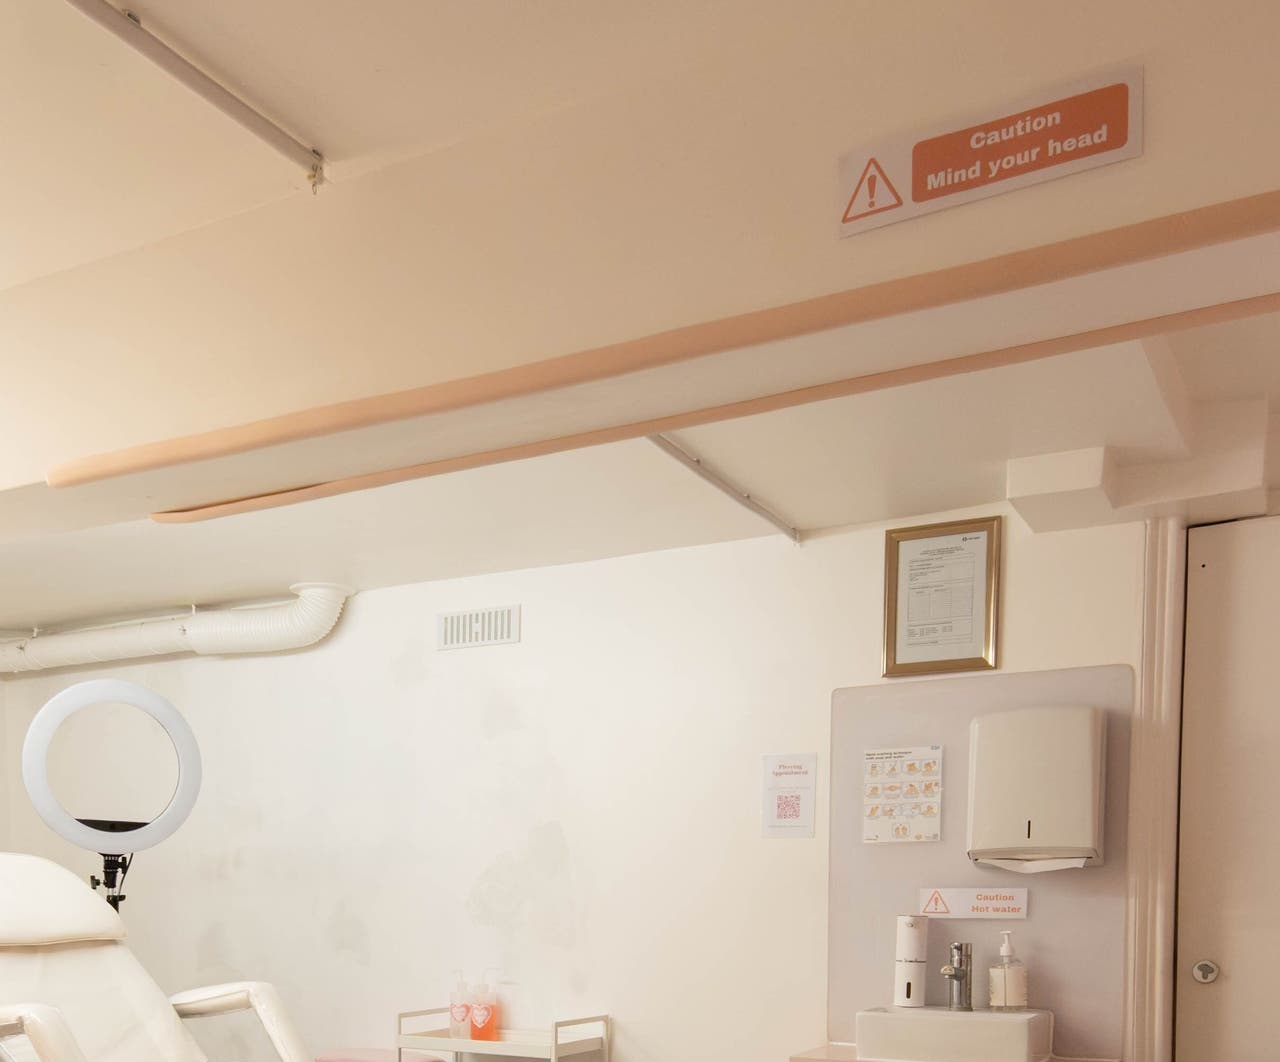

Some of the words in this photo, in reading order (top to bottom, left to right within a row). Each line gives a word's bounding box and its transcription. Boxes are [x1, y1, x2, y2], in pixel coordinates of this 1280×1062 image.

[970, 111, 1061, 149] Caution
[926, 161, 981, 191] Mind
[988, 147, 1041, 178] your
[1048, 125, 1108, 156] head
[971, 905, 990, 913] Hot
